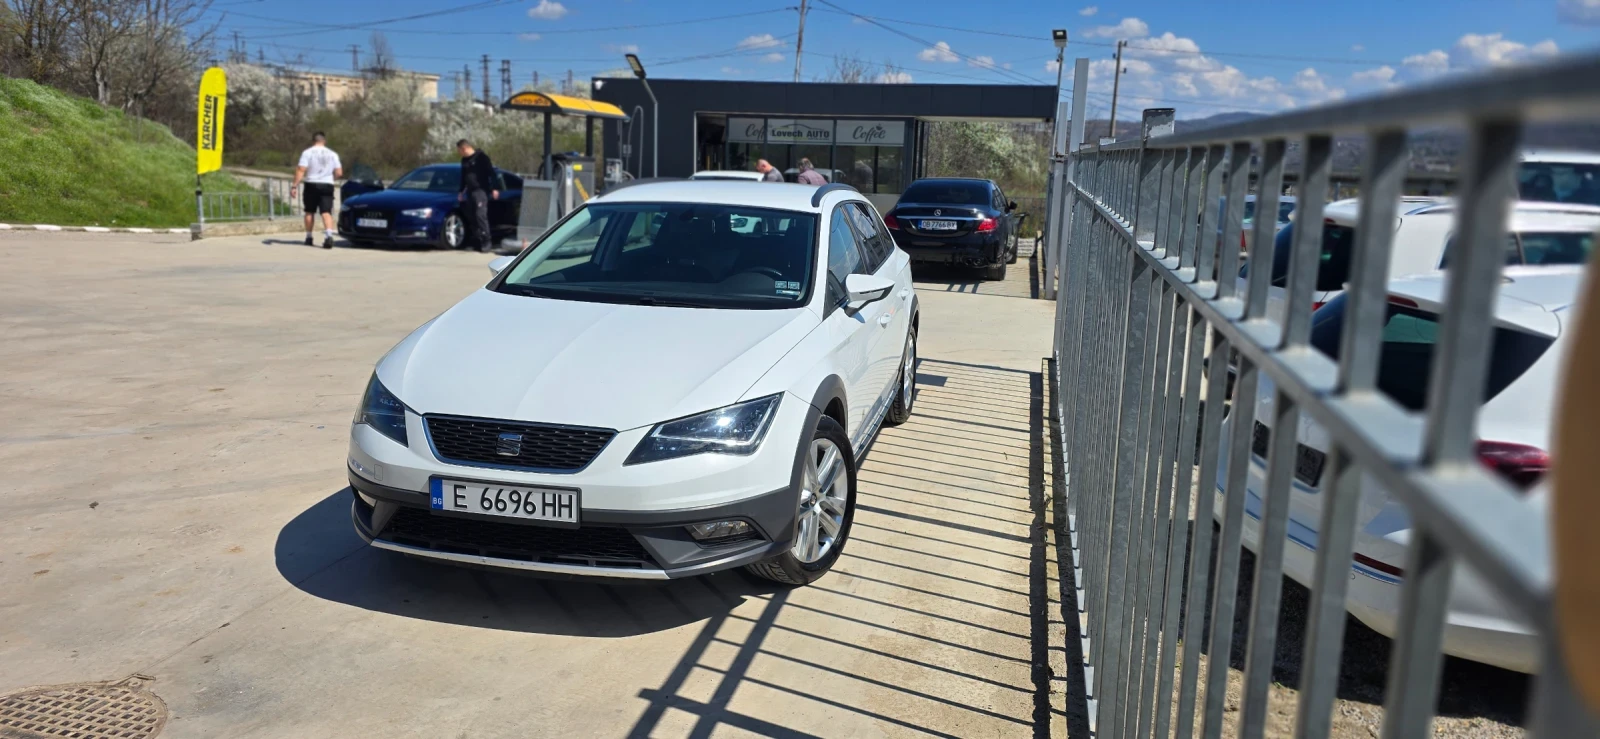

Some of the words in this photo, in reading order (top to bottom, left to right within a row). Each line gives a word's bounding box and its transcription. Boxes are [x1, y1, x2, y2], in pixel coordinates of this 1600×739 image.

[772, 129, 803, 138] Lovech
[806, 130, 830, 138] AUTO
[852, 125, 886, 143] Coffee
[453, 484, 468, 509] E
[480, 487, 537, 515] 6696
[541, 492, 573, 519] HH
